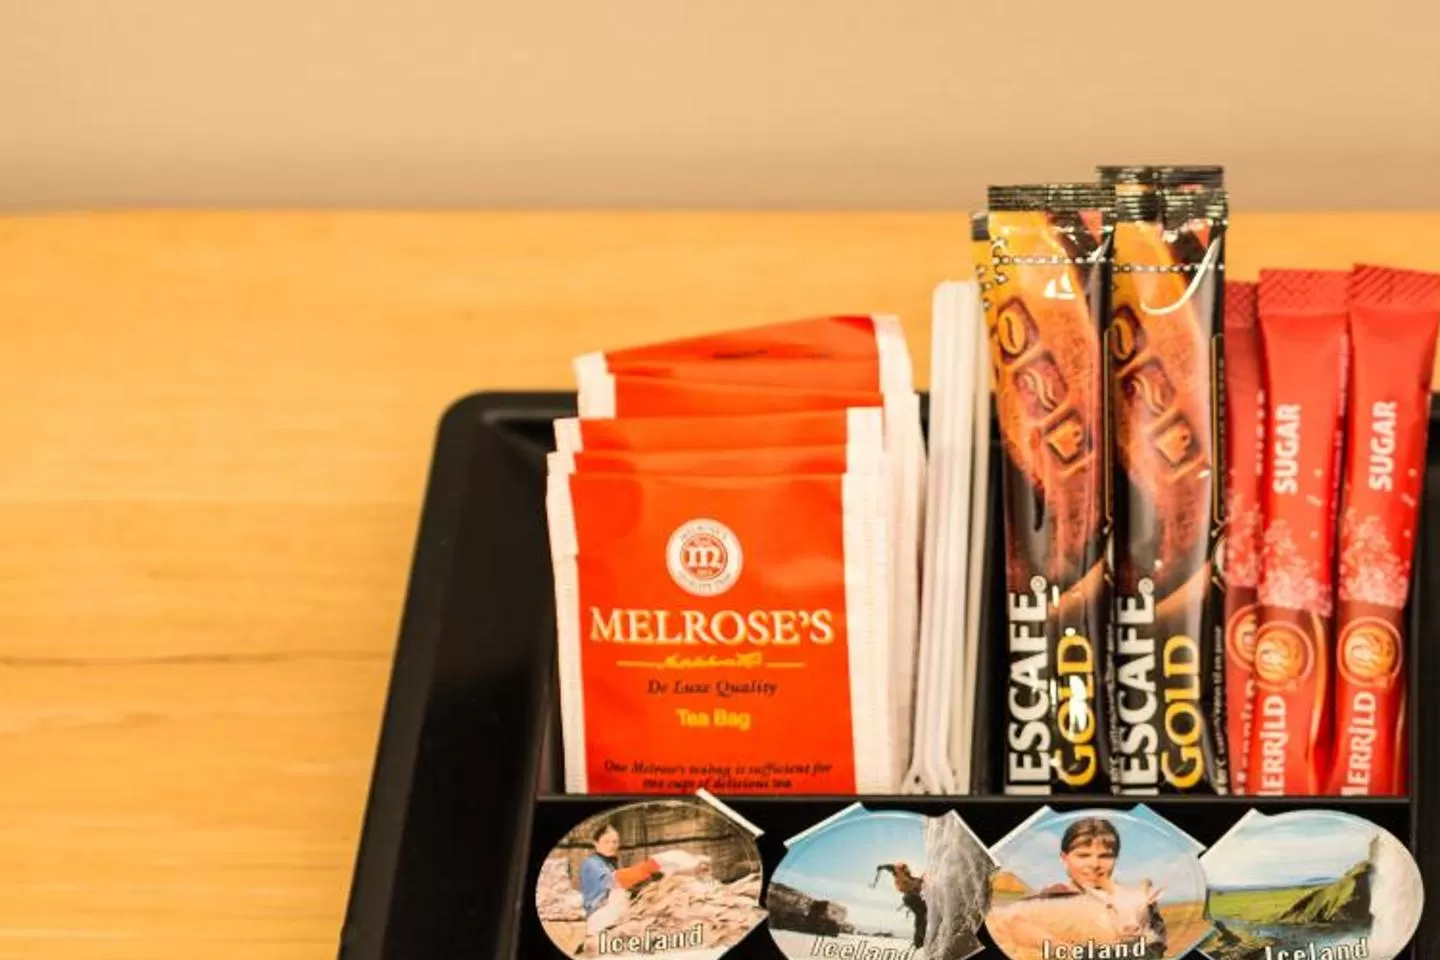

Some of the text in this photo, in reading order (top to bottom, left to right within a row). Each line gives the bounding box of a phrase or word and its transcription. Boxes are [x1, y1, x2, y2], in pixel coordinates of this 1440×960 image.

[1272, 402, 1302, 496] SUGAR
[1368, 400, 1398, 493] SUGAR
[588, 606, 835, 646] MELROSE'S
[647, 680, 668, 694] De
[715, 679, 778, 697] Quality
[675, 707, 752, 731] Tea Bag
[1055, 634, 1097, 787] GOLD
[1161, 634, 1205, 789] GOLD
[599, 922, 704, 955] Iceland
[1042, 935, 1147, 960] Iceland
